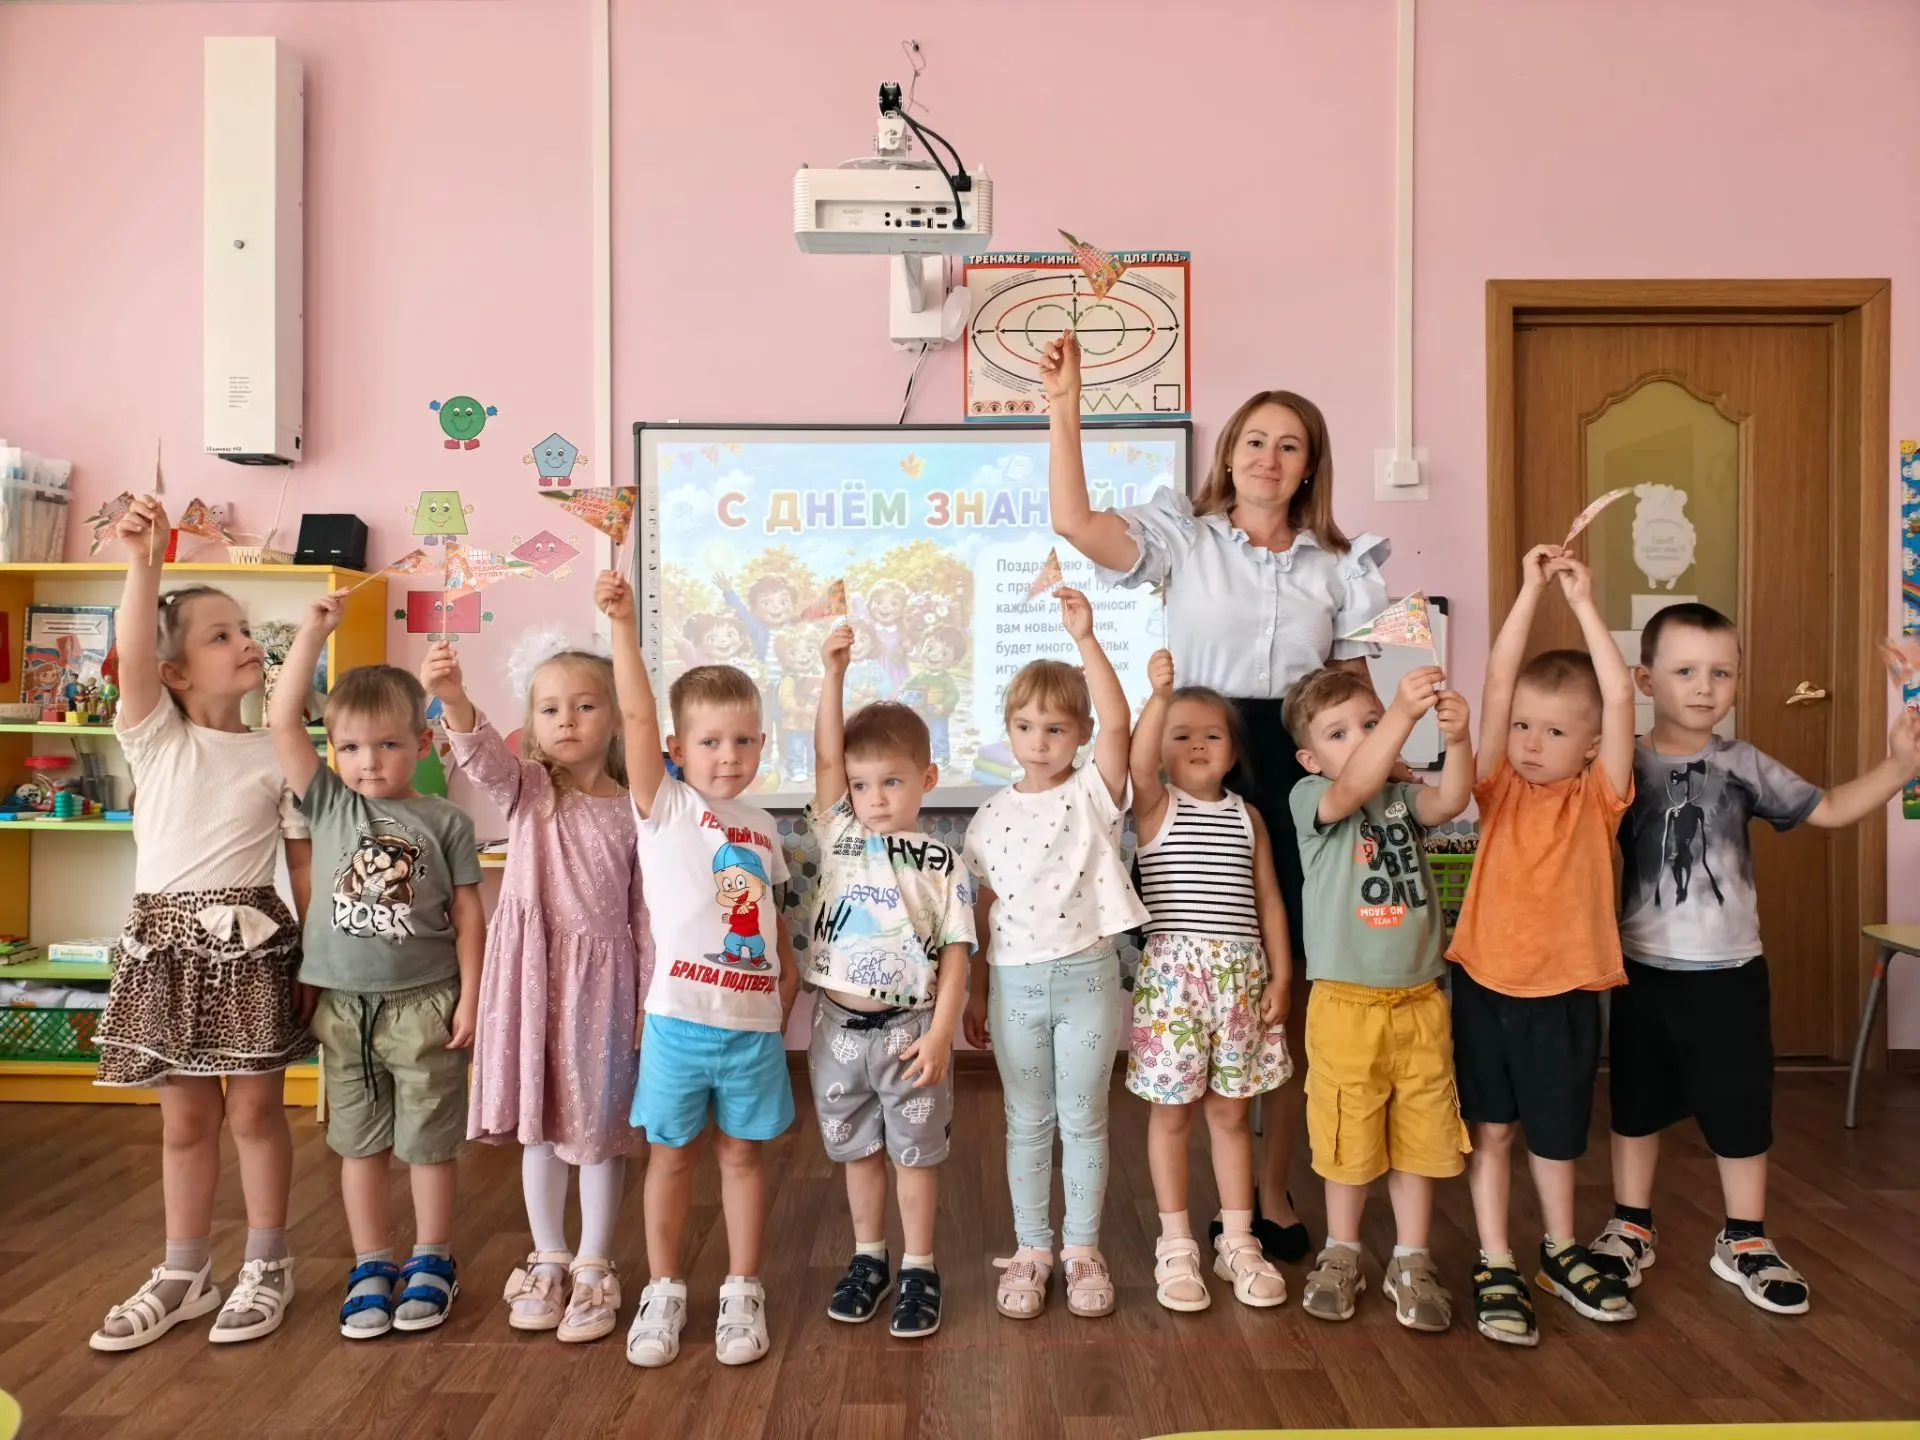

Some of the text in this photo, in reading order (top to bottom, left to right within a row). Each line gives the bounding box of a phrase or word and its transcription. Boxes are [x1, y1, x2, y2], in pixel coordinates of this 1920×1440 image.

[968, 253, 1030, 264] ТРЕНАЖЁР
[1123, 253, 1148, 263] ДЛЯ
[1151, 253, 1187, 263] ГЛАЗ»
[717, 481, 1134, 533] С ДНЁМ ЗНАНЙ!
[996, 559, 1082, 573] Поздраяю
[996, 583, 1003, 592] с
[1008, 578, 1091, 595] праиком!
[996, 600, 1046, 614] каждый
[1090, 601, 1136, 611] риносит
[996, 623, 1020, 633] вам
[1024, 622, 1065, 632] новые
[996, 640, 1031, 657] будет
[1036, 642, 1073, 652] много
[700, 811, 752, 843] РЕНЫЙ
[1360, 906, 1403, 916] MOVE ON
[858, 957, 887, 970] GET
[669, 959, 720, 986] БРАТВА
[850, 969, 901, 985] READY
